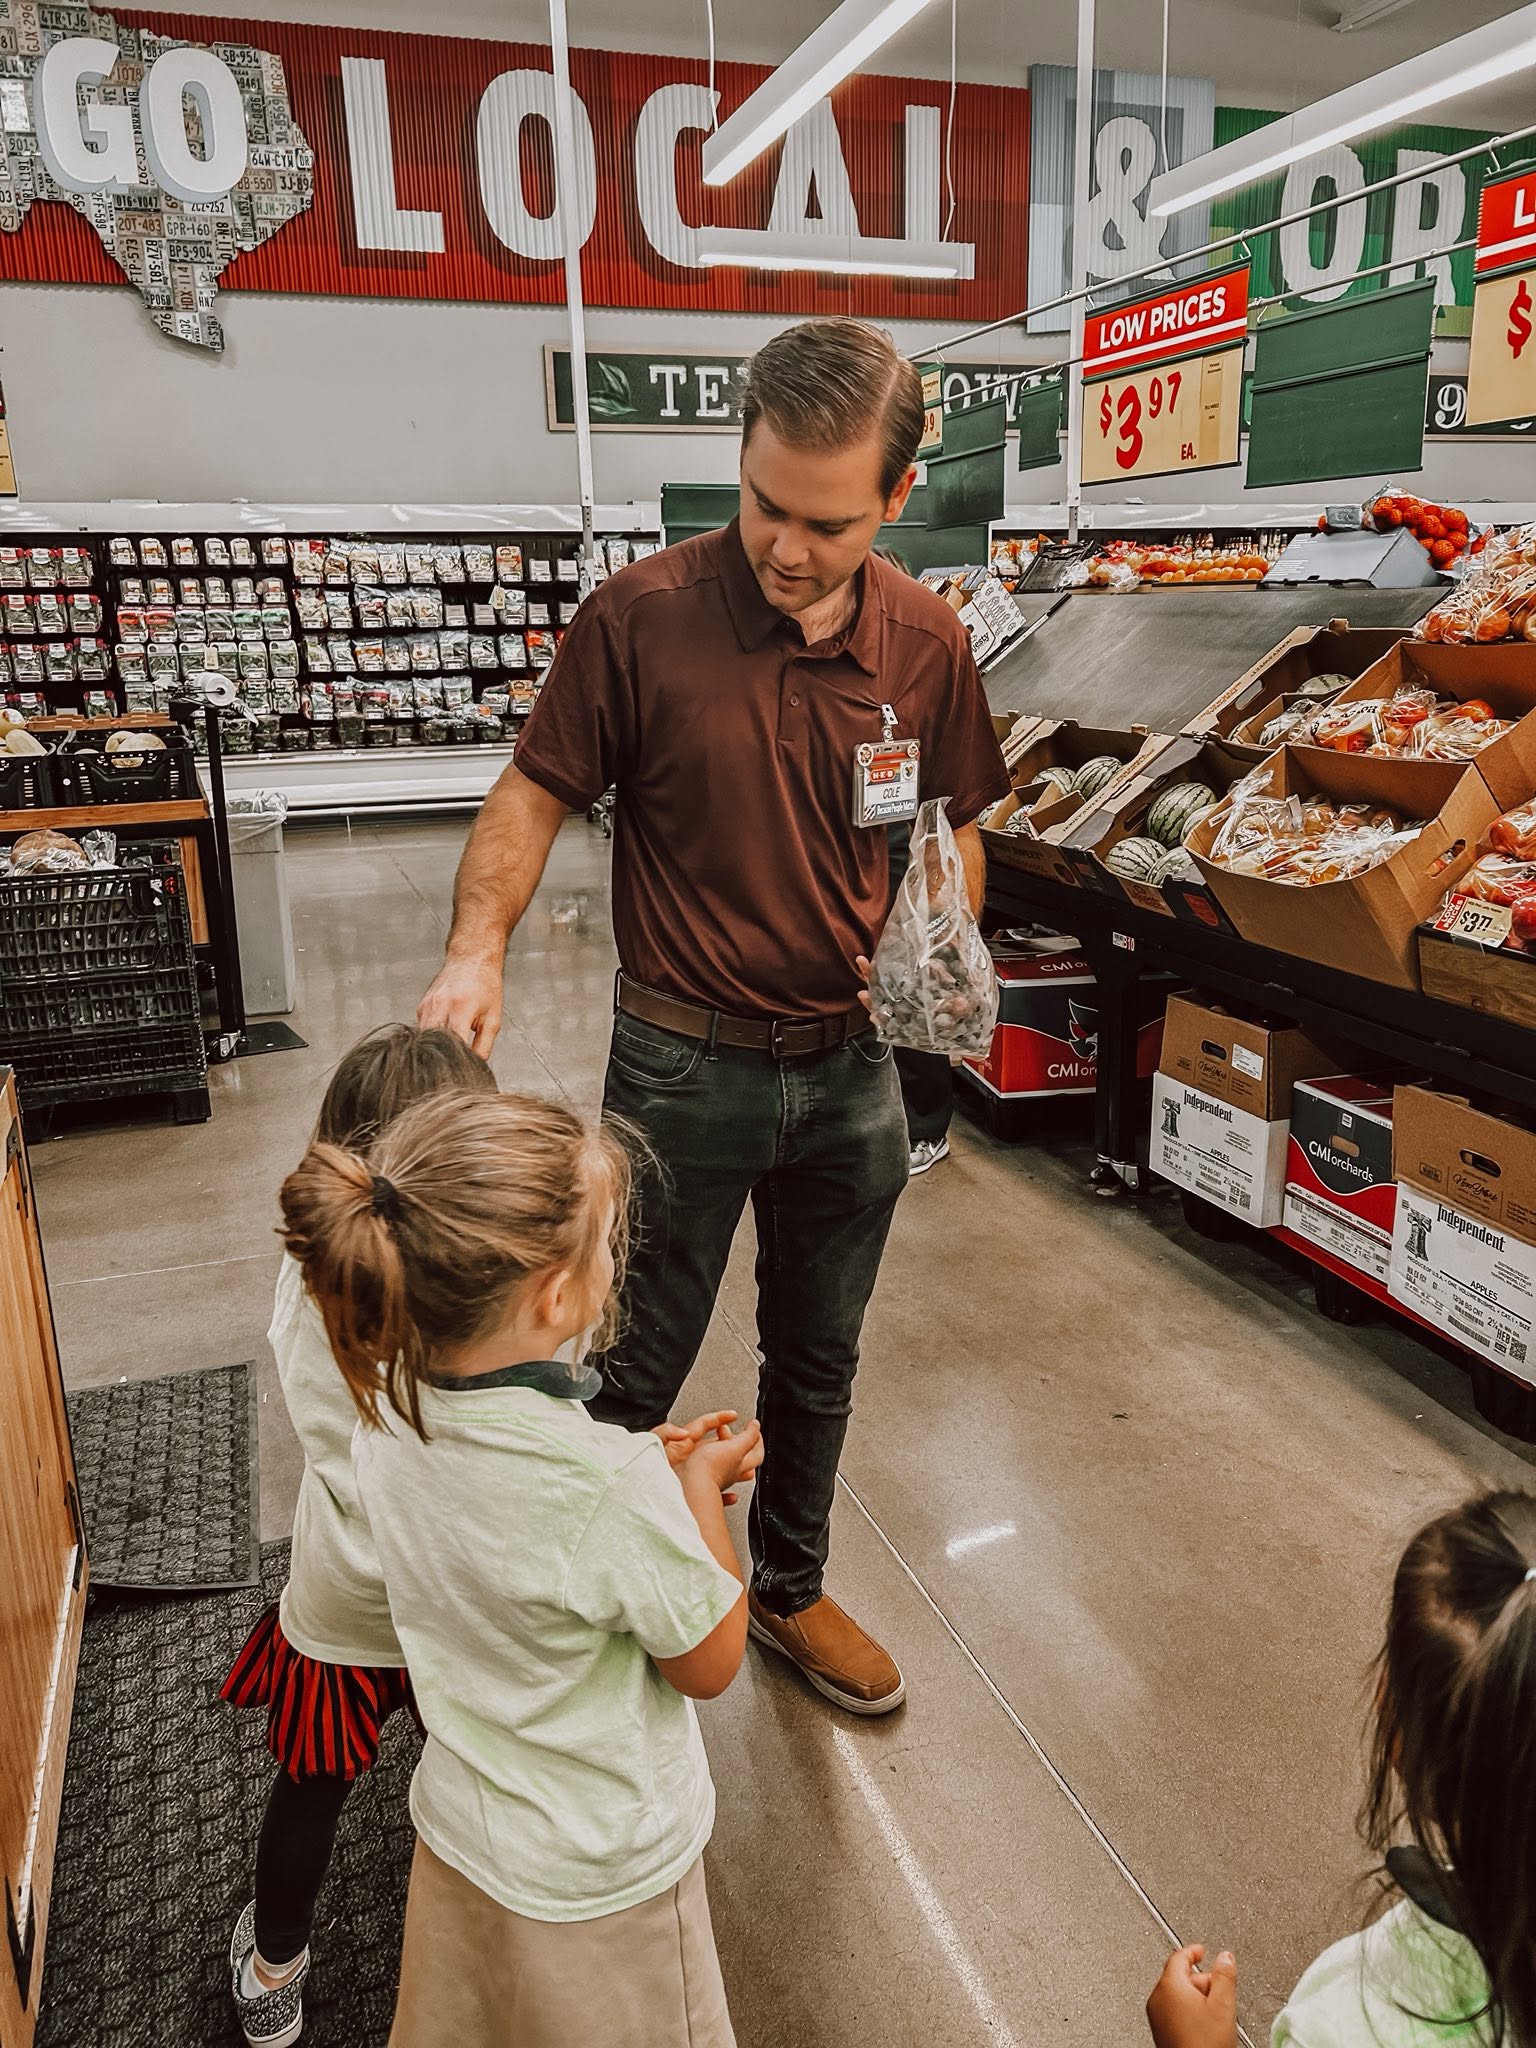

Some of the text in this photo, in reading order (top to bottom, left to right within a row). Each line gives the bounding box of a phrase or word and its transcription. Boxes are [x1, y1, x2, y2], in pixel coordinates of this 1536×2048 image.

[40, 36, 248, 194] GO
[340, 55, 976, 280] LOCAL
[1086, 115, 1176, 280] &
[1100, 286, 1226, 349] LOW PRICES
[1181, 442, 1197, 461] EA.
[883, 786, 901, 800] COLE
[1441, 902, 1456, 923] LOW
[1443, 899, 1464, 928] PRICES
[1040, 961, 1073, 972] CMI
[1047, 1063, 1079, 1078] CMI
[1184, 1089, 1234, 1123] Independent
[1308, 1140, 1375, 1184] CMI orchards
[1436, 1202, 1506, 1253] Independent
[1470, 1280, 1498, 1301] APPLES
